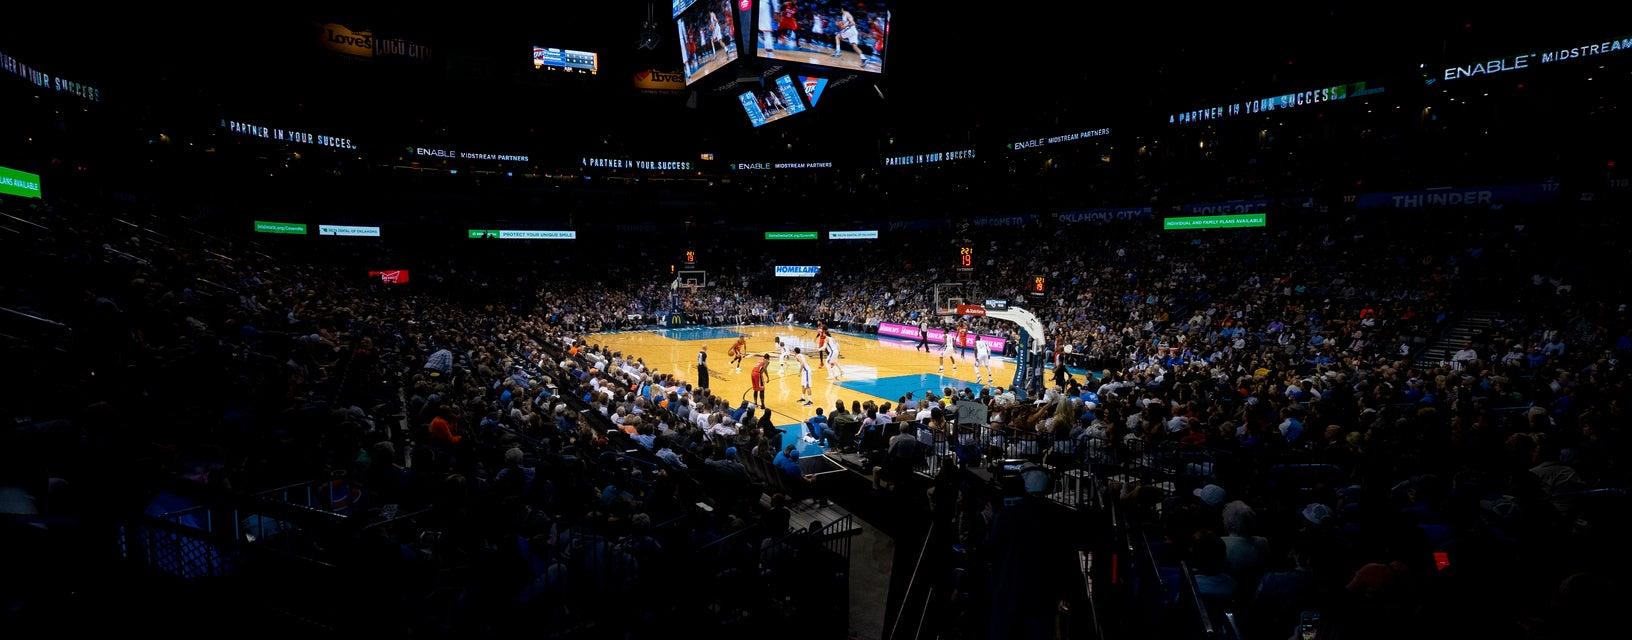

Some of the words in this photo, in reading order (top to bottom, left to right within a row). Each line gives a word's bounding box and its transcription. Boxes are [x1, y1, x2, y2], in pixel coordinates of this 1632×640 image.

[1444, 54, 1529, 80] ENABLE
[1541, 38, 1632, 63] MIDSTREAM
[55, 77, 101, 102] SUCCESS
[1168, 114, 1175, 124] A
[1178, 106, 1223, 124] PARTNER
[1229, 104, 1240, 116] IN
[1245, 99, 1275, 114] YOUR
[1280, 86, 1339, 109] SUCCESS
[230, 120, 269, 138] PARTNER
[273, 128, 284, 140] IN
[288, 130, 314, 144] YOUR
[1014, 138, 1045, 150] ENABLE
[1047, 133, 1079, 144] MIDSTREAM
[1080, 127, 1110, 138] PARTNERS
[416, 147, 456, 158] ENABLE
[460, 152, 497, 160] MIDSTREAM
[885, 155, 914, 166] PARTNER
[916, 154, 924, 163] IN
[926, 152, 942, 163] YOUR
[945, 149, 976, 160] SUCCESS
[589, 158, 622, 168] PARTNER
[625, 160, 633, 169] IN
[636, 160, 655, 169] YOUR
[657, 161, 691, 170] SUCCESS
[738, 162, 771, 170] ENABLE
[1391, 190, 1493, 209] THUNDER
[1012, 216, 1023, 225] TO
[1116, 209, 1142, 221] CITY
[962, 254, 971, 266] 19
[958, 404, 985, 420] OKC
